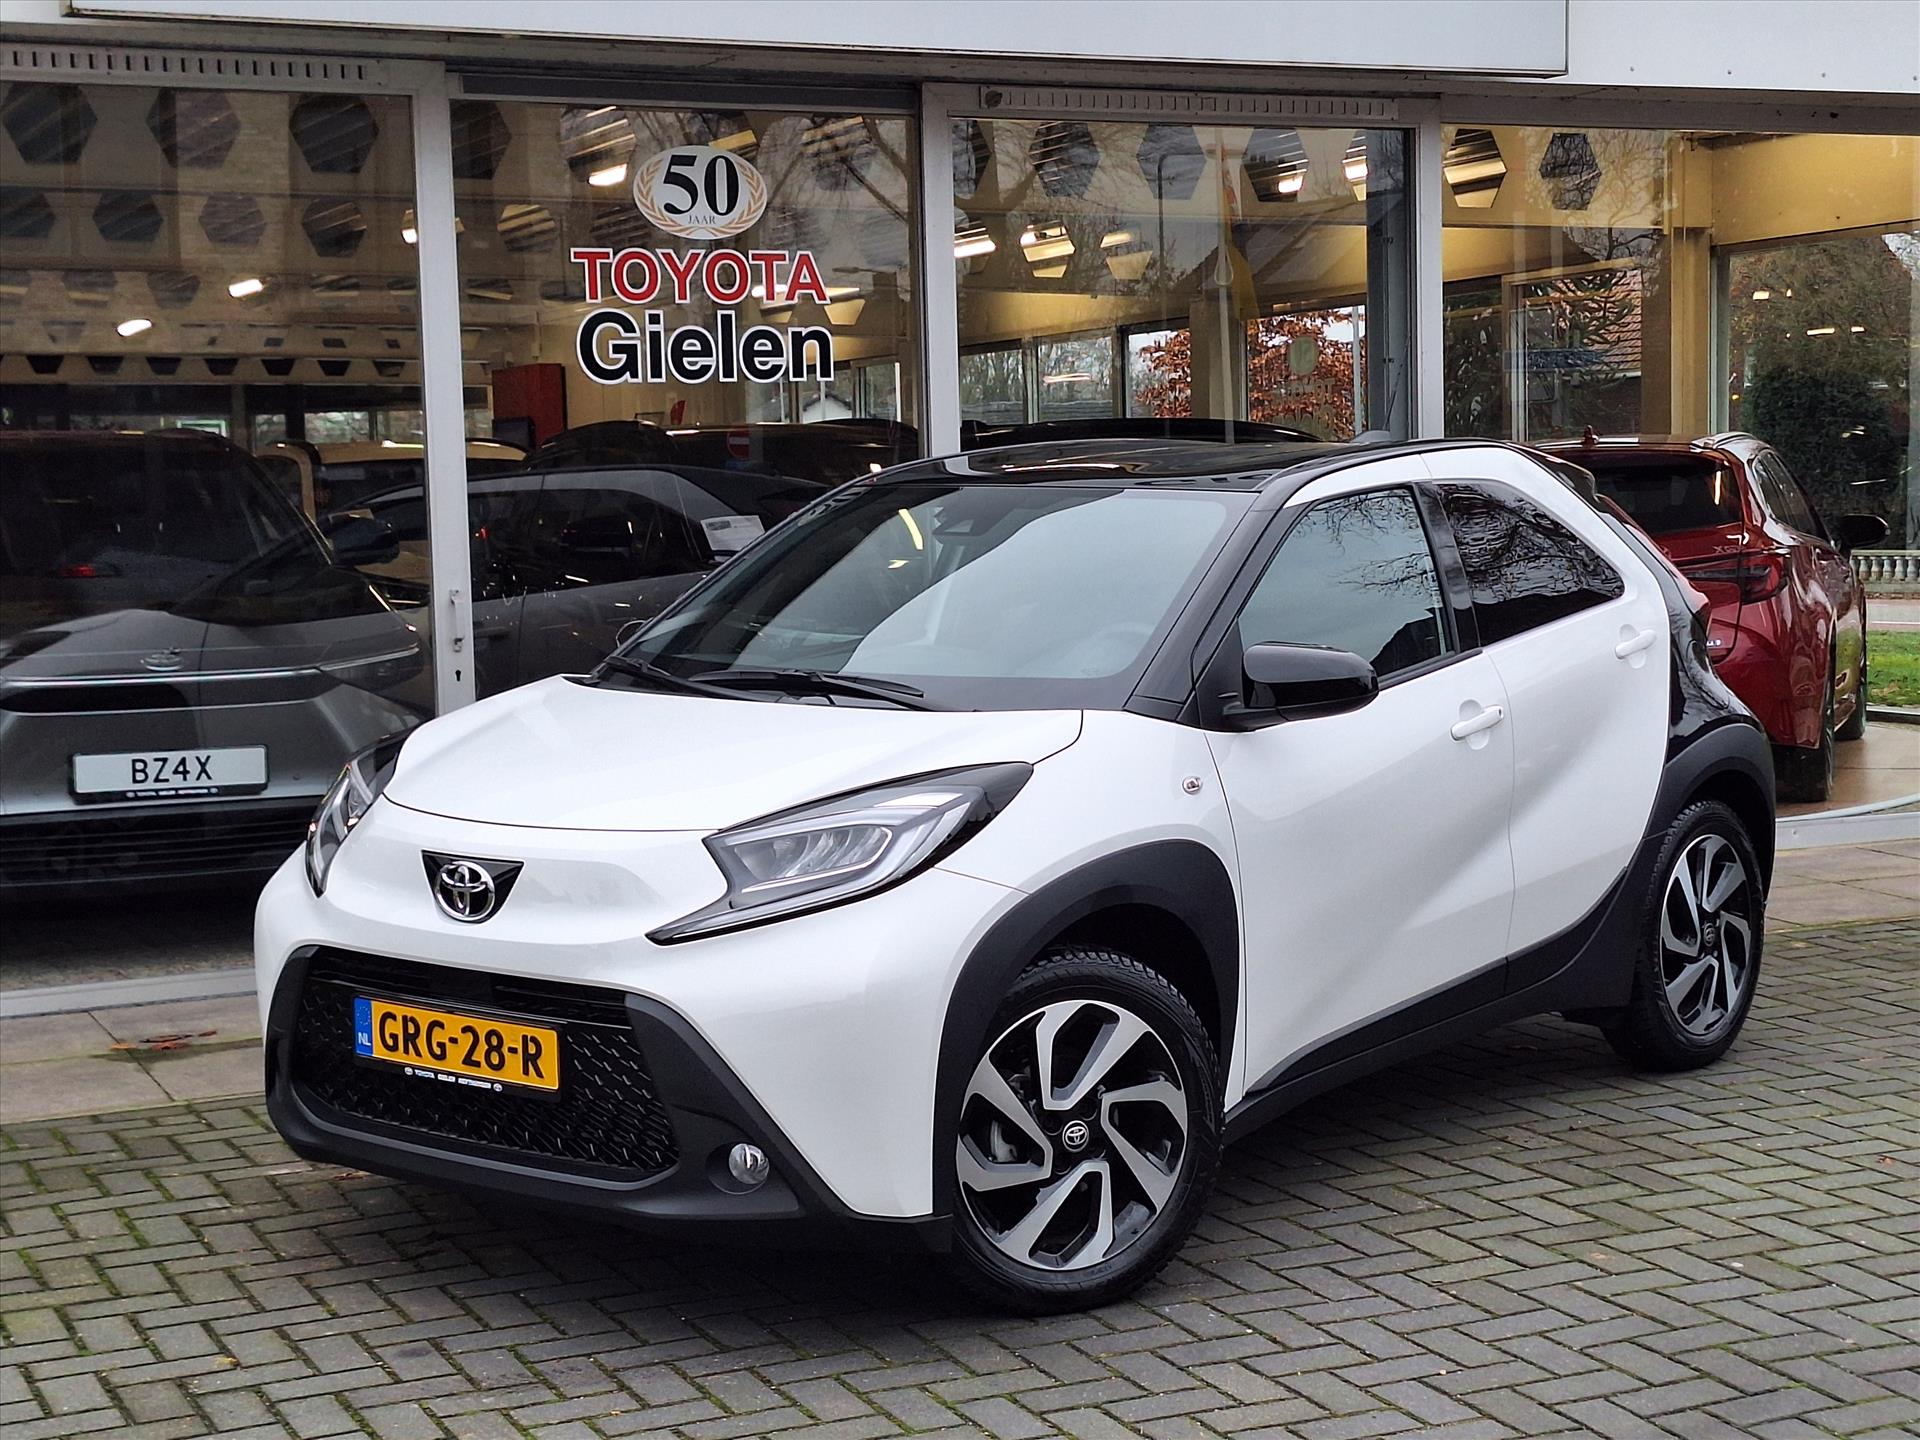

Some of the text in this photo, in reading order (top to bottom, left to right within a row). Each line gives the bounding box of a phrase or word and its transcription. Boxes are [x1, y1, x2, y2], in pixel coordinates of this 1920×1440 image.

[663, 155, 739, 216] 50
[688, 215, 716, 225] JAAR
[571, 248, 830, 304] TOYOTA
[577, 308, 834, 384] Gielen
[131, 755, 213, 784] BZ4X
[358, 1032, 371, 1046] NL
[378, 1011, 545, 1079] GRG-28-R
